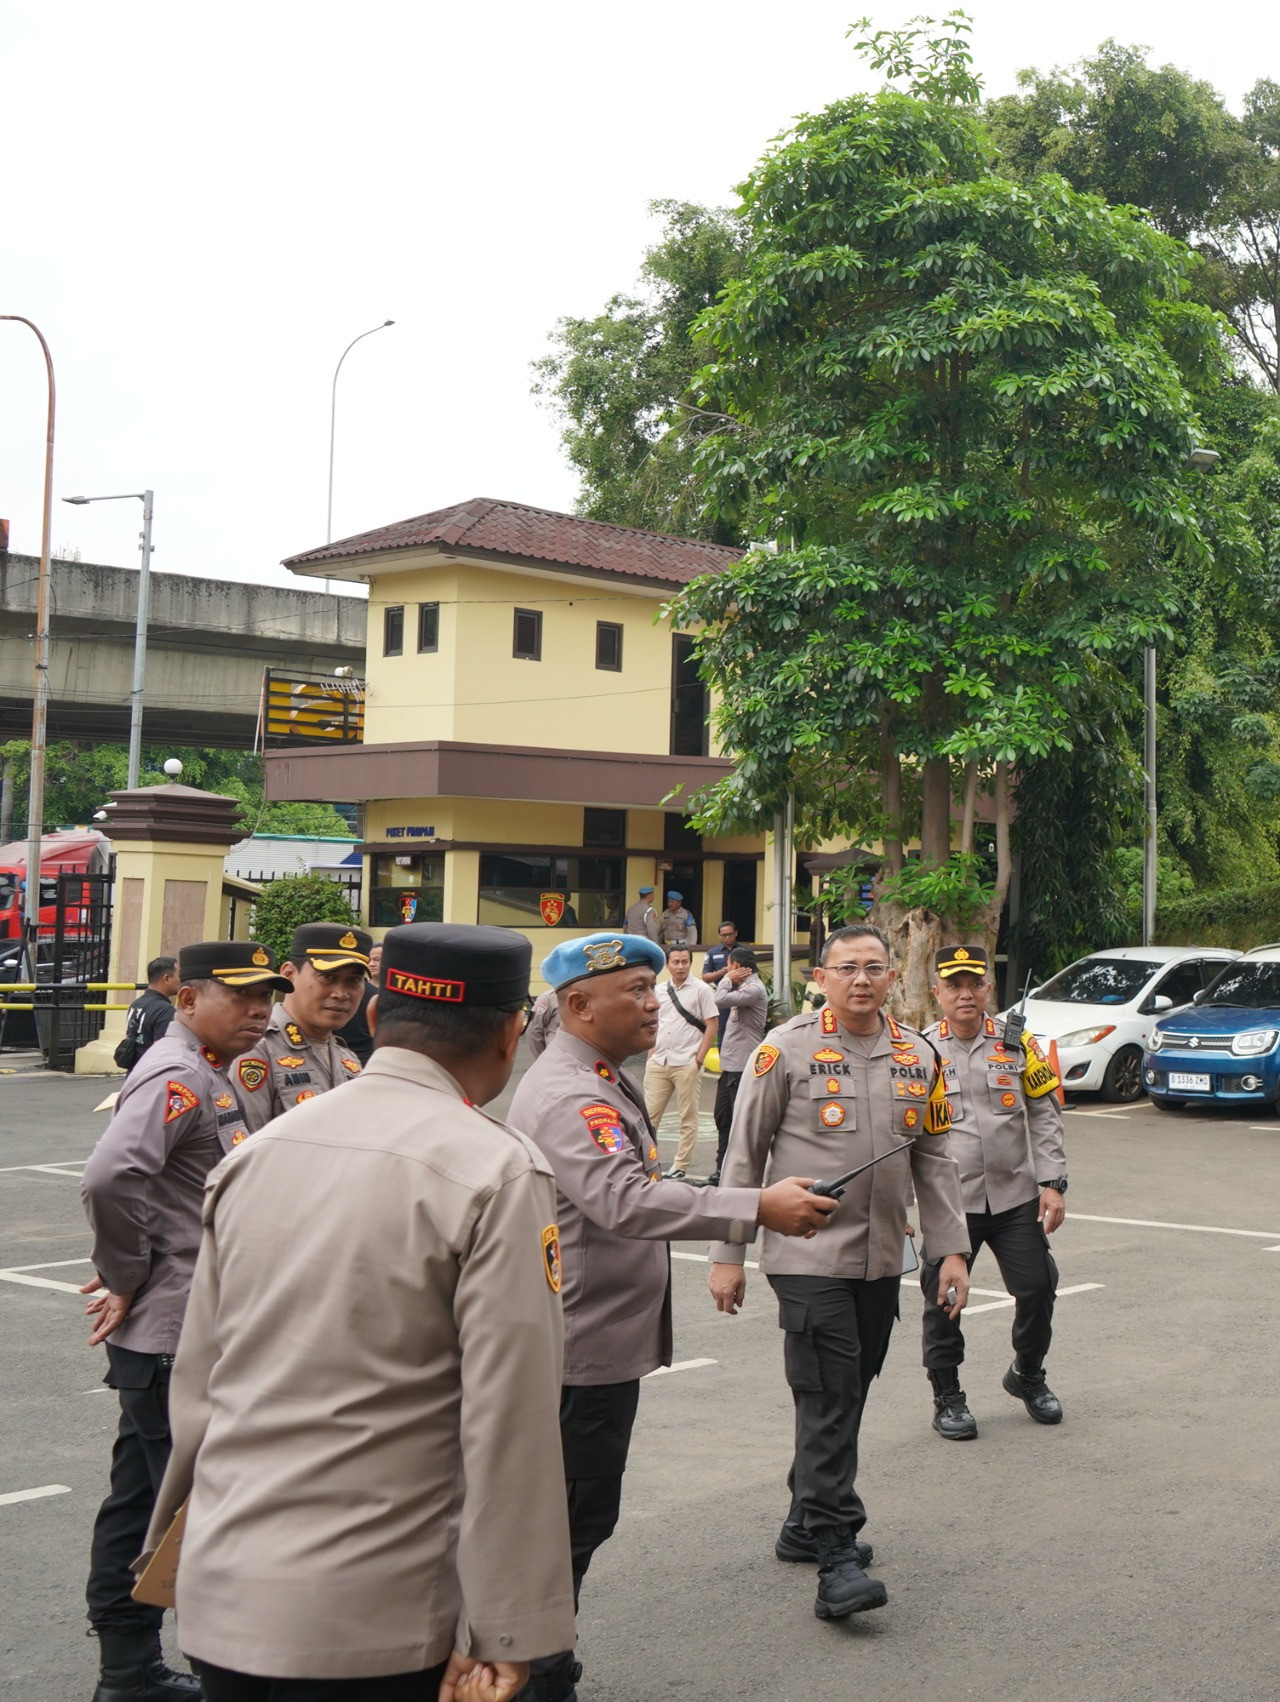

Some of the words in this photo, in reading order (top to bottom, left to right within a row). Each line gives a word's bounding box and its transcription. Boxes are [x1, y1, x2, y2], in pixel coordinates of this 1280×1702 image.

[394, 974, 452, 997] TAHTI
[810, 1063, 851, 1076] ERICK
[890, 1066, 927, 1079] POLRI
[988, 1064, 1018, 1072] POLRI
[1171, 1074, 1176, 1084] B
[1177, 1075, 1194, 1085] 1336
